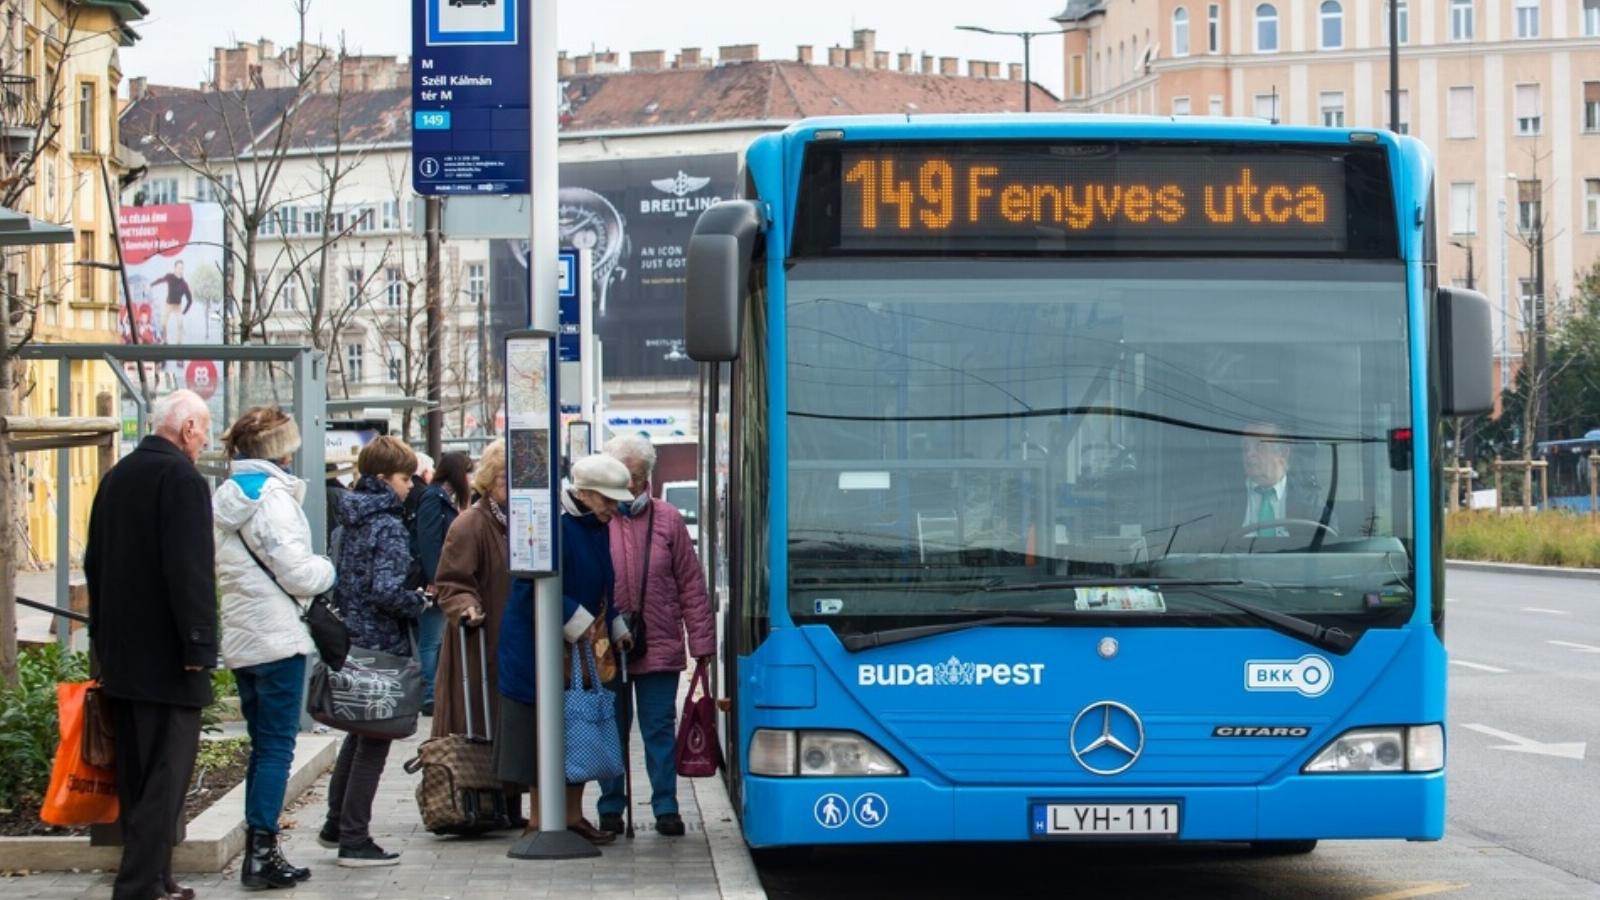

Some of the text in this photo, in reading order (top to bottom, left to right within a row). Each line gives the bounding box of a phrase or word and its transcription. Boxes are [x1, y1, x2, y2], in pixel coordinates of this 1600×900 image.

[421, 59, 434, 69] M
[421, 74, 493, 86] Széll Kálmán
[421, 89, 452, 100] tér M
[422, 114, 444, 126] 149
[846, 159, 1327, 230] 149 Fenyves utca
[641, 246, 682, 256] AN ICON
[641, 258, 687, 269] JUST GOT
[1257, 669, 1293, 682] BKK
[1216, 727, 1308, 737] CITARO
[1036, 807, 1169, 831] H LYH-111
